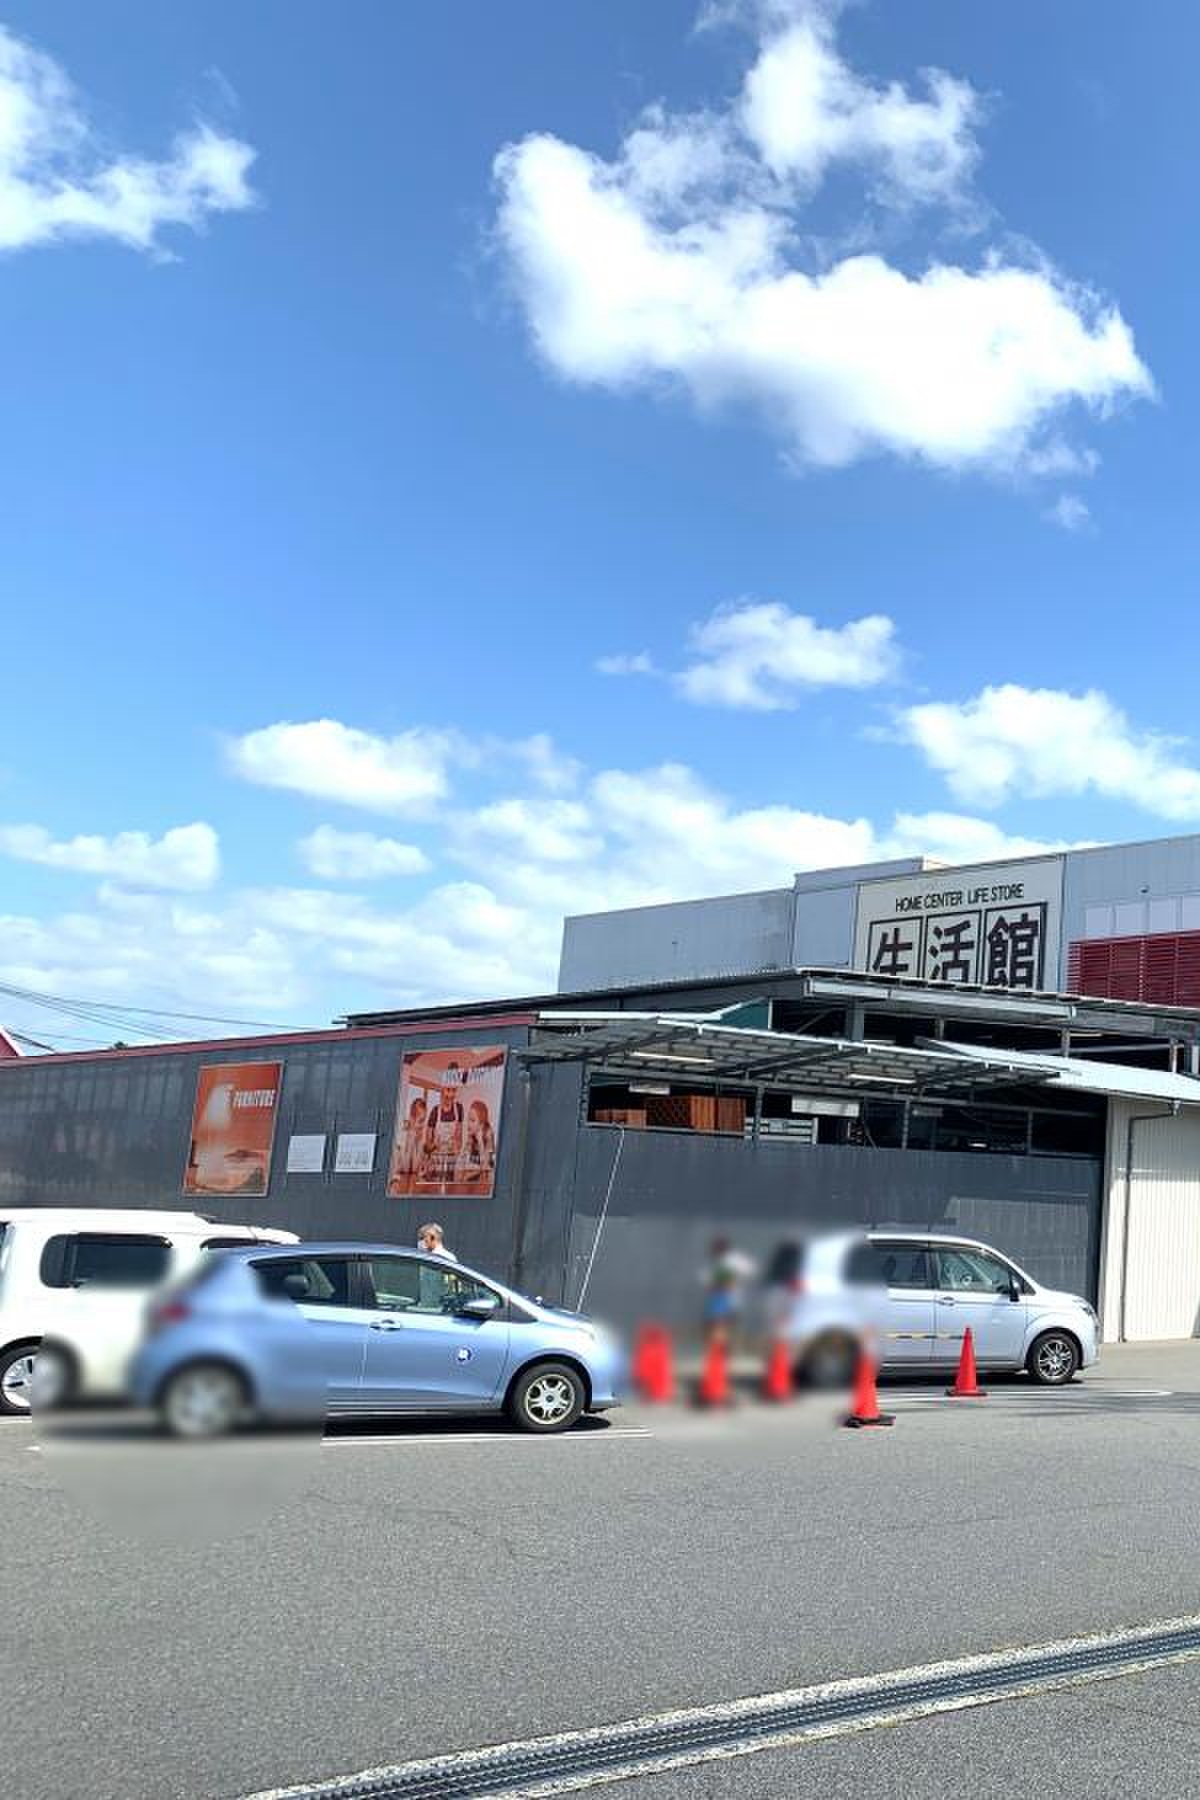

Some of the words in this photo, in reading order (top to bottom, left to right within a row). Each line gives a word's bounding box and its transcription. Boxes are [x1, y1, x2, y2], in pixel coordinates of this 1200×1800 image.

[895, 895, 923, 912] HOME
[924, 891, 963, 909] CENTER
[967, 887, 989, 904] LIFE
[991, 883, 1024, 900] STORE
[872, 912, 1039, 988] 生活館
